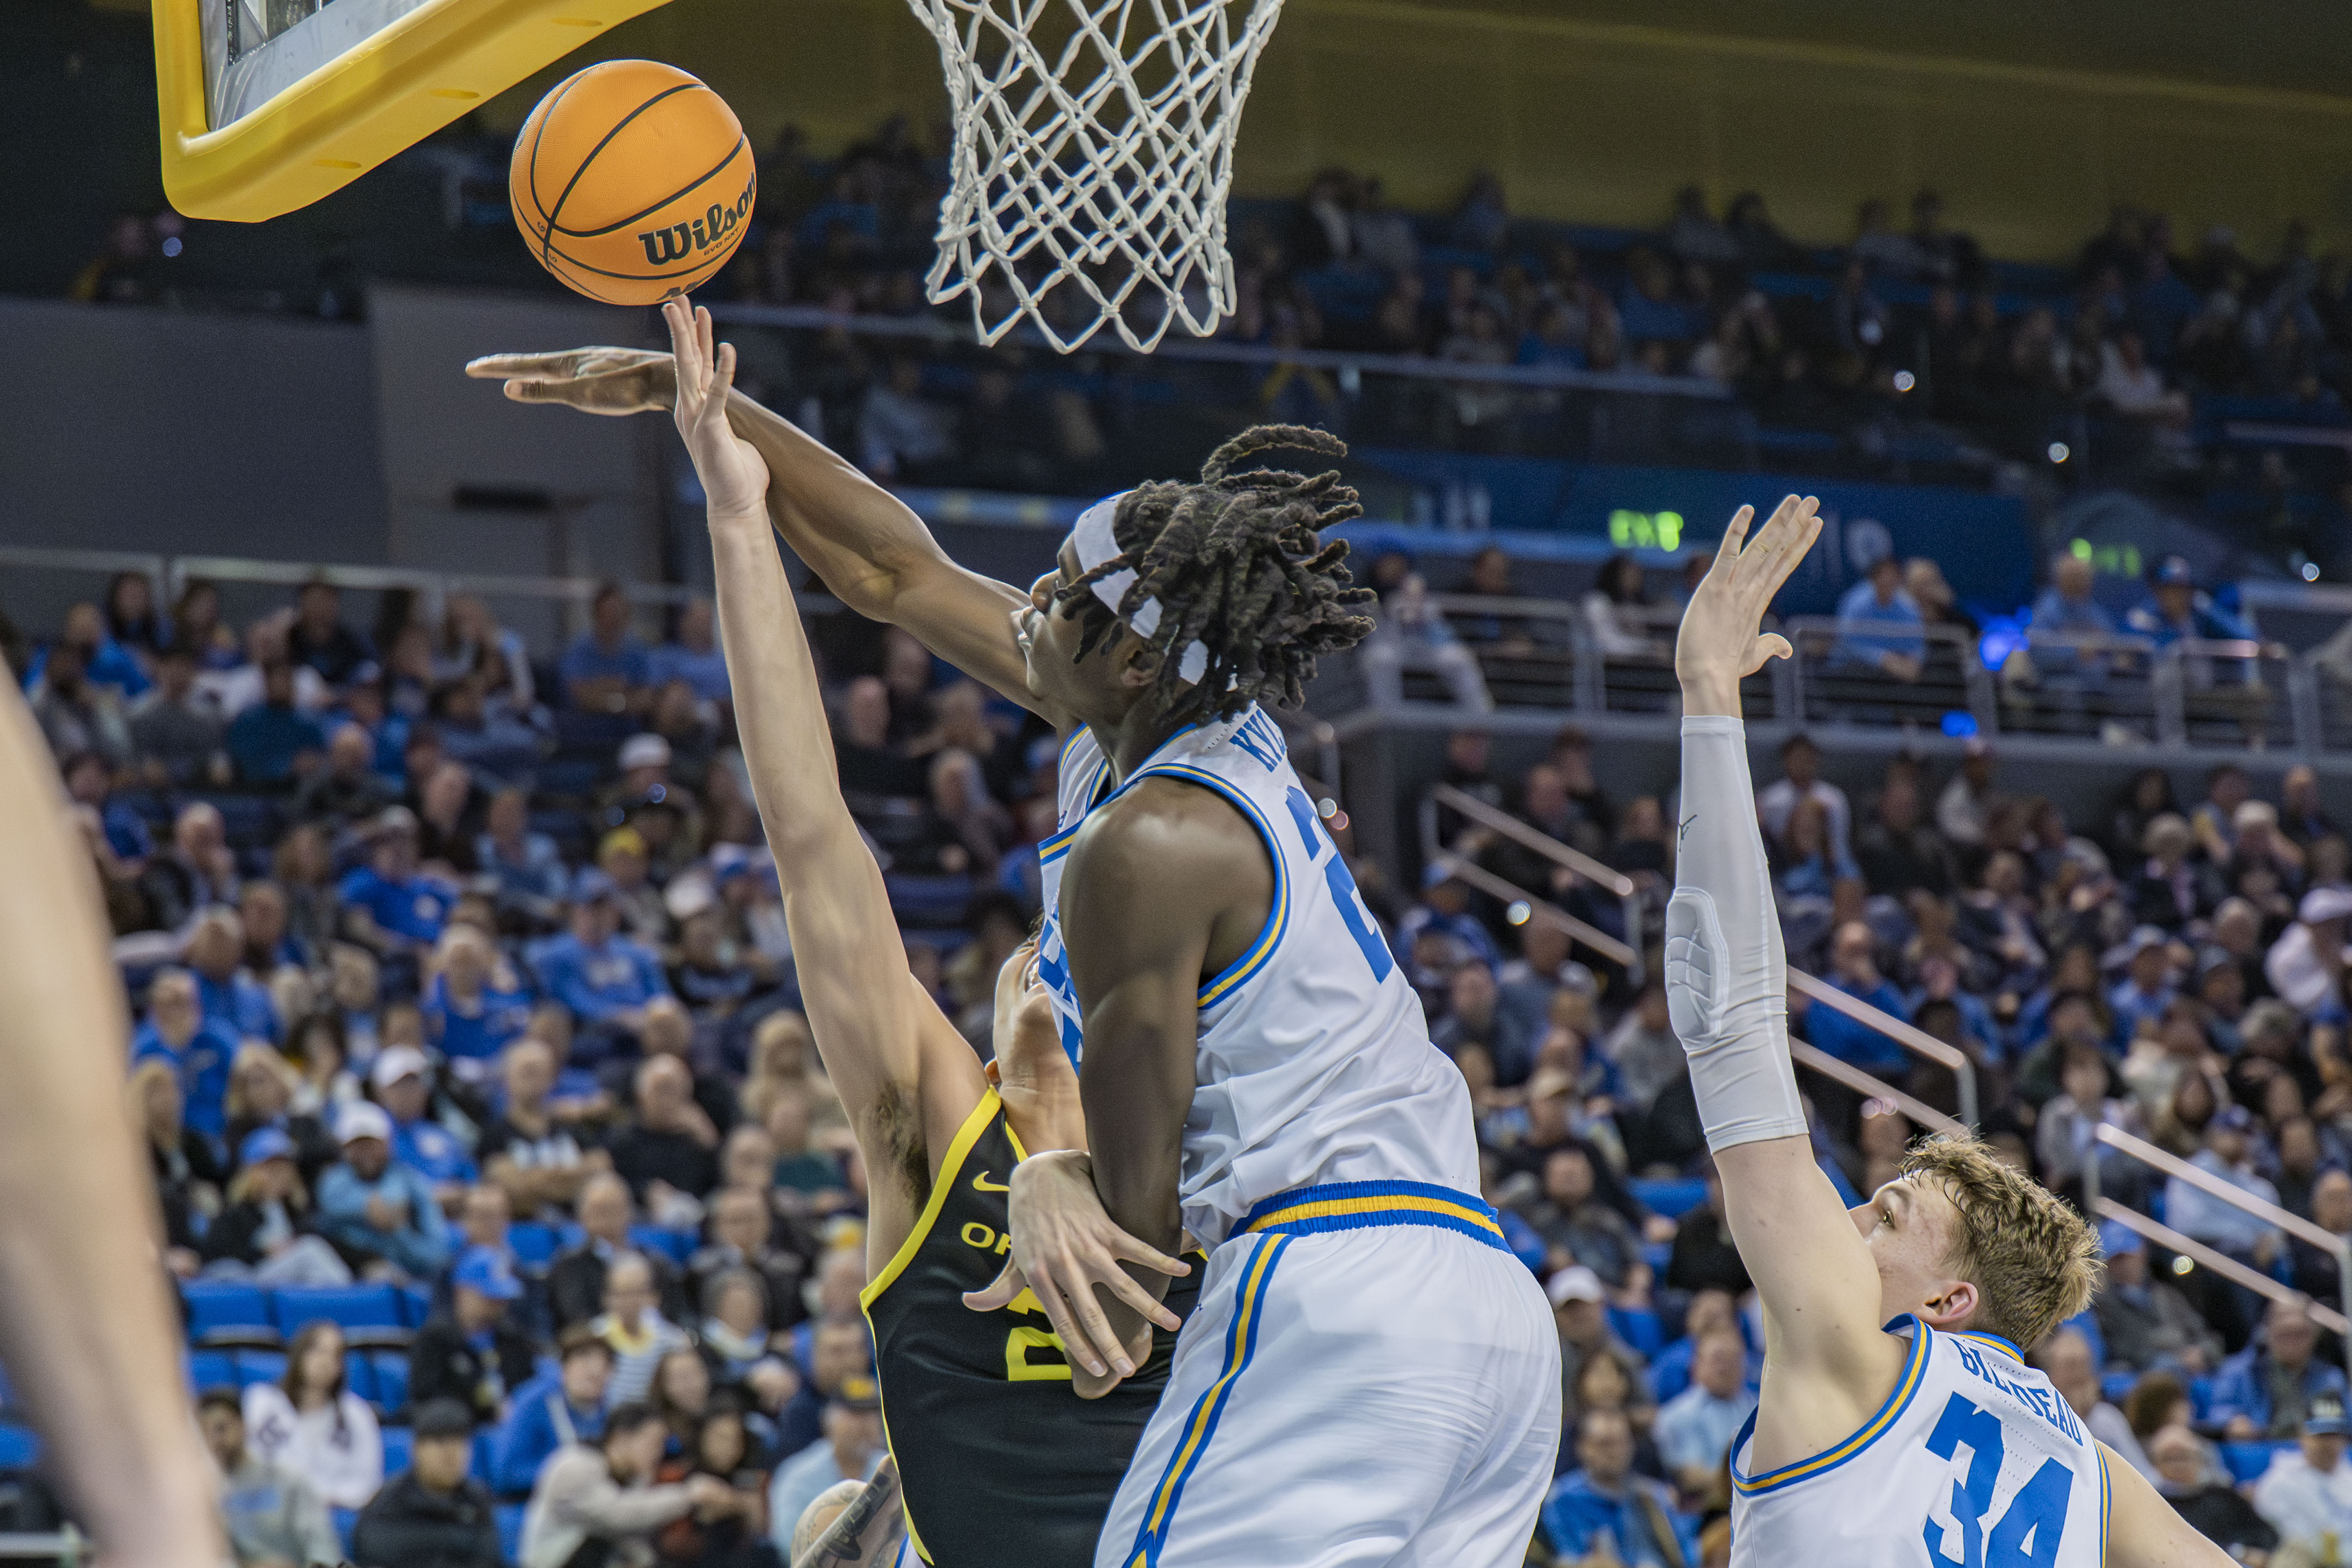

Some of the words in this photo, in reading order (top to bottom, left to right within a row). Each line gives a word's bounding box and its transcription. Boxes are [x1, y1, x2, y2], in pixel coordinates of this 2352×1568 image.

[638, 171, 756, 265] Wilson
[704, 240, 723, 257] EVO
[1923, 1391, 2074, 1568] 34
